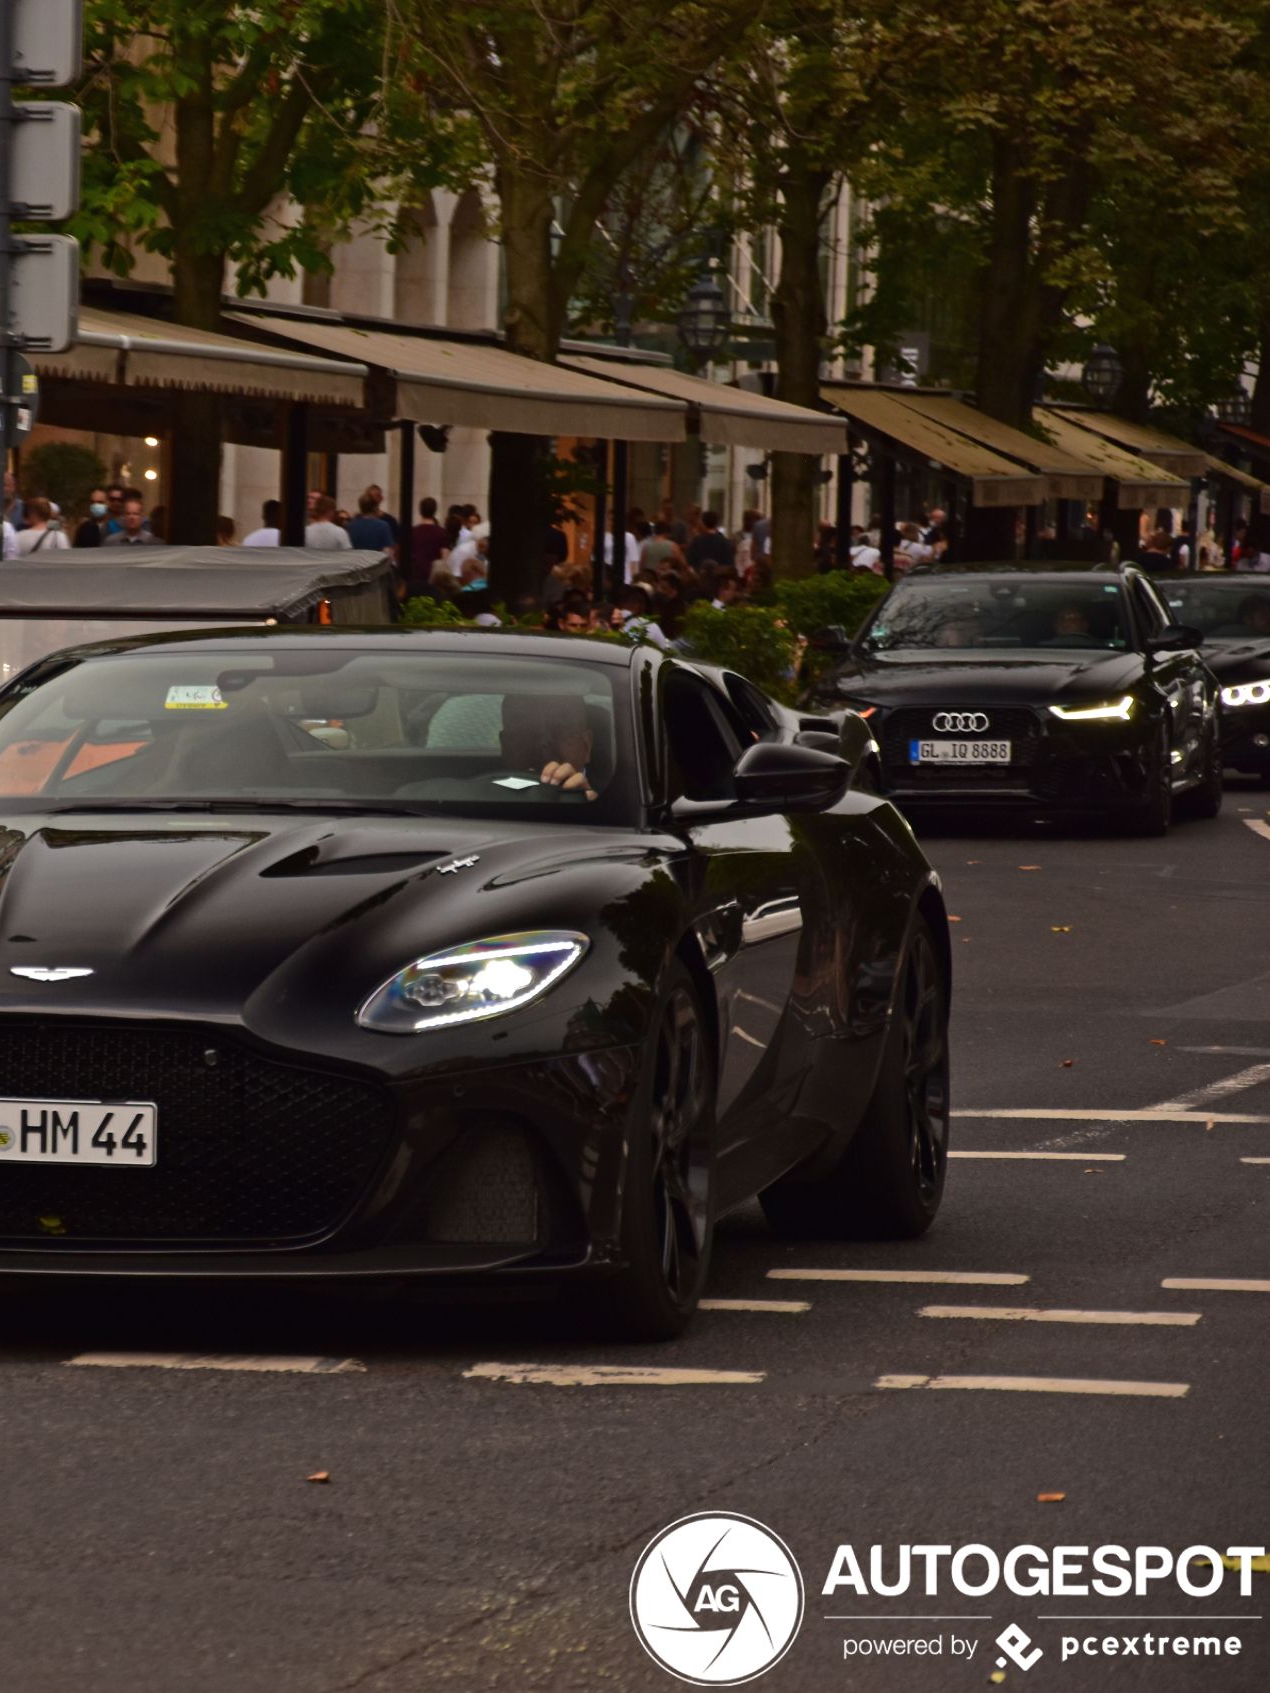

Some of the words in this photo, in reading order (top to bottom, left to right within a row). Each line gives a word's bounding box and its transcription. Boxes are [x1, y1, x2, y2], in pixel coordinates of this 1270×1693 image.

[920, 743, 939, 759] GL
[951, 743, 968, 759] IQ
[972, 743, 1008, 759] 8888
[20, 1109, 79, 1154] HM
[91, 1112, 147, 1157] 44
